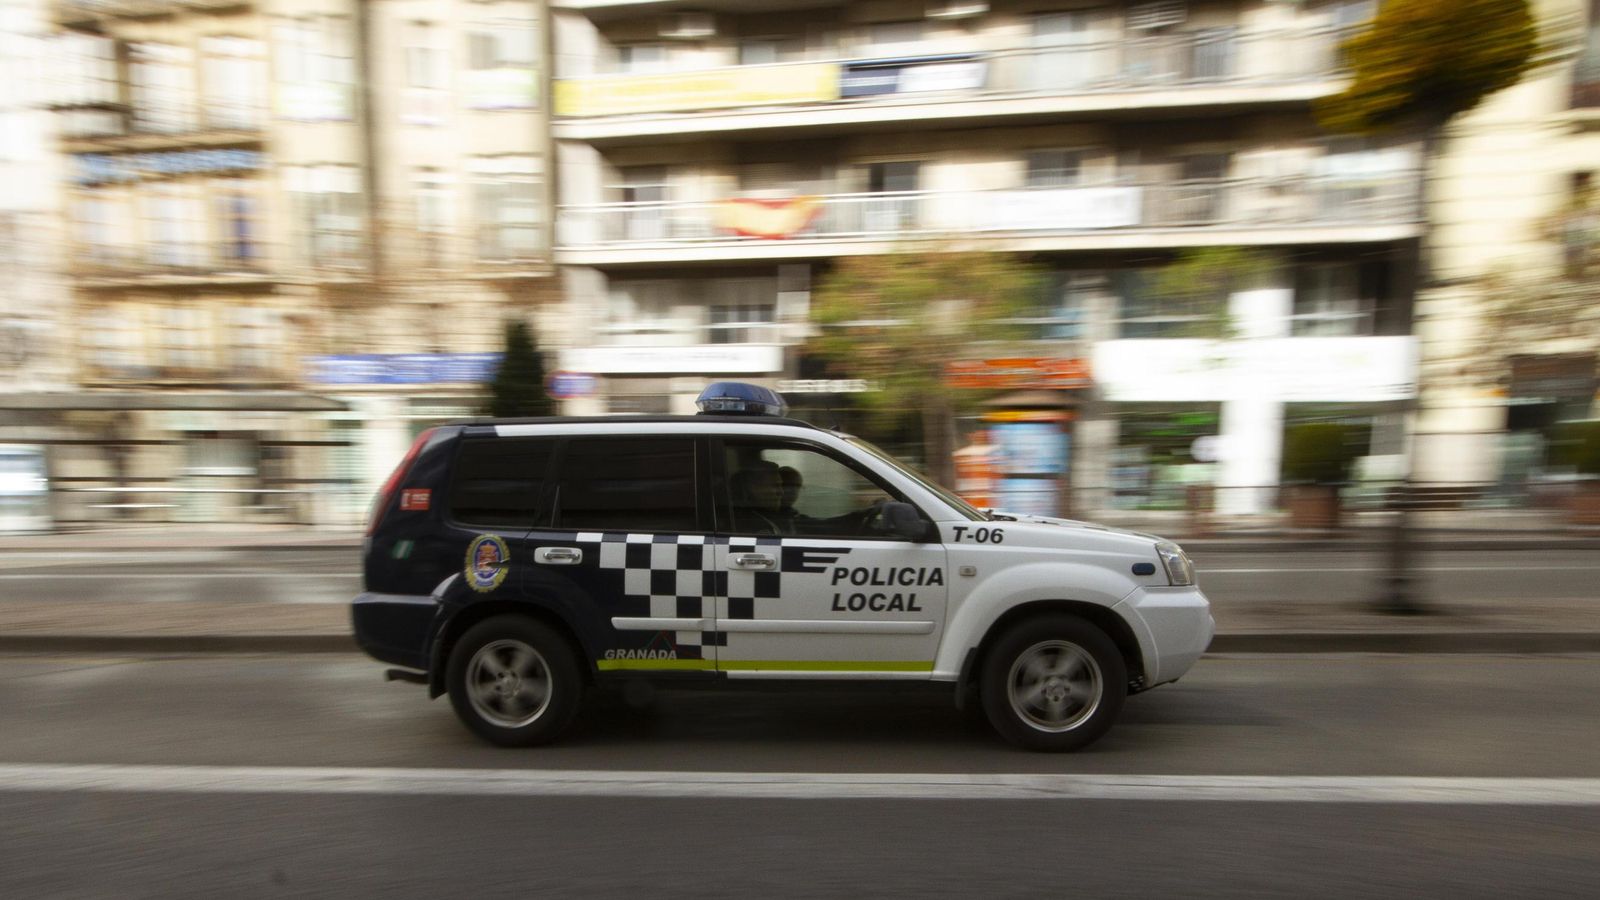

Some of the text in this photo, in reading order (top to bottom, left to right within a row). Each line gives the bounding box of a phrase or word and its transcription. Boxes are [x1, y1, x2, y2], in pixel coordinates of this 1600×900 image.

[952, 526, 1004, 544] T-06
[831, 567, 944, 586] POLICIA
[831, 593, 922, 612] LOCAL
[604, 648, 678, 660] GRANADA
